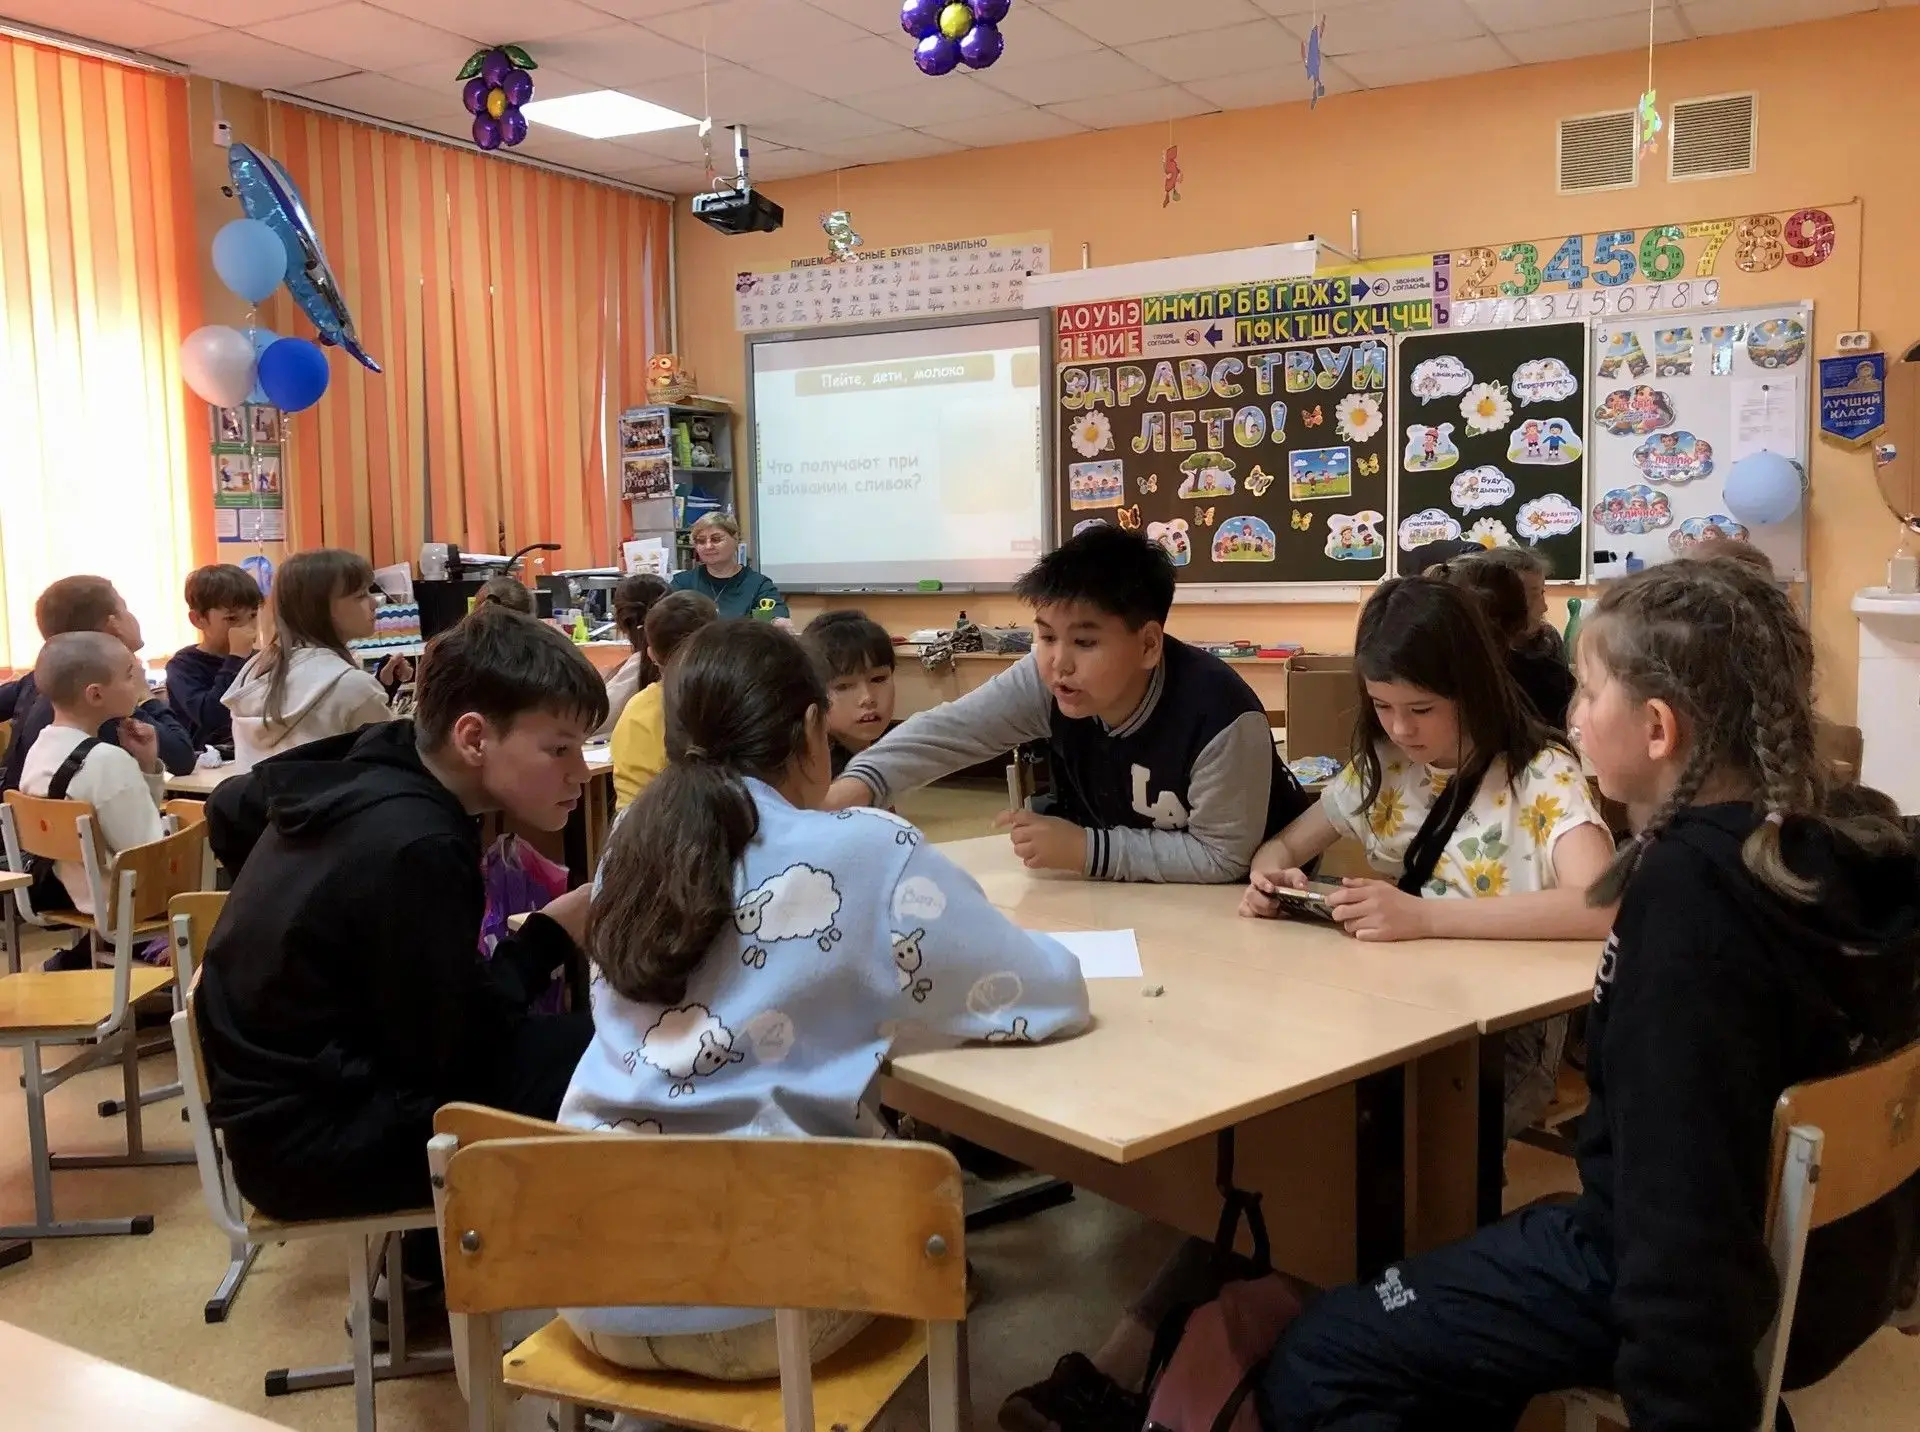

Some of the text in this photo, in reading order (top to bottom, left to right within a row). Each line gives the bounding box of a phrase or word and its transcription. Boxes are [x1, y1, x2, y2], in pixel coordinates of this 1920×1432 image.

[790, 255, 825, 269] ПИШЕМ
[890, 246, 923, 258] БУКВЫ
[928, 238, 988, 253] ПРАВИЛЬНО
[1499, 243, 1541, 296] 3
[1542, 235, 1589, 289] 4
[1591, 231, 1637, 287] 5
[1639, 224, 1685, 282] 6
[1687, 220, 1734, 278] 7
[1735, 214, 1784, 273] 8
[1784, 209, 1835, 267] 9
[1512, 296, 1527, 321] 2
[1541, 294, 1554, 320] 3
[1566, 292, 1580, 317] 4
[1589, 289, 1606, 316] 5
[1617, 287, 1634, 313] 6
[1645, 284, 1661, 311] 7
[1671, 281, 1690, 309] 8
[1701, 279, 1719, 306] 9
[872, 370, 907, 385] дети,
[913, 364, 965, 380] молоко
[1061, 341, 1387, 410] ЗДРАВСТВУЙ
[1824, 393, 1881, 409] ЛУЧШИЙ
[1830, 406, 1876, 419] КЛАСС
[1132, 401, 1288, 454] ЛЕТО!
[766, 455, 919, 475] Что получают при
[767, 473, 922, 497] взбивании сливок?
[1131, 763, 1189, 830] LA
